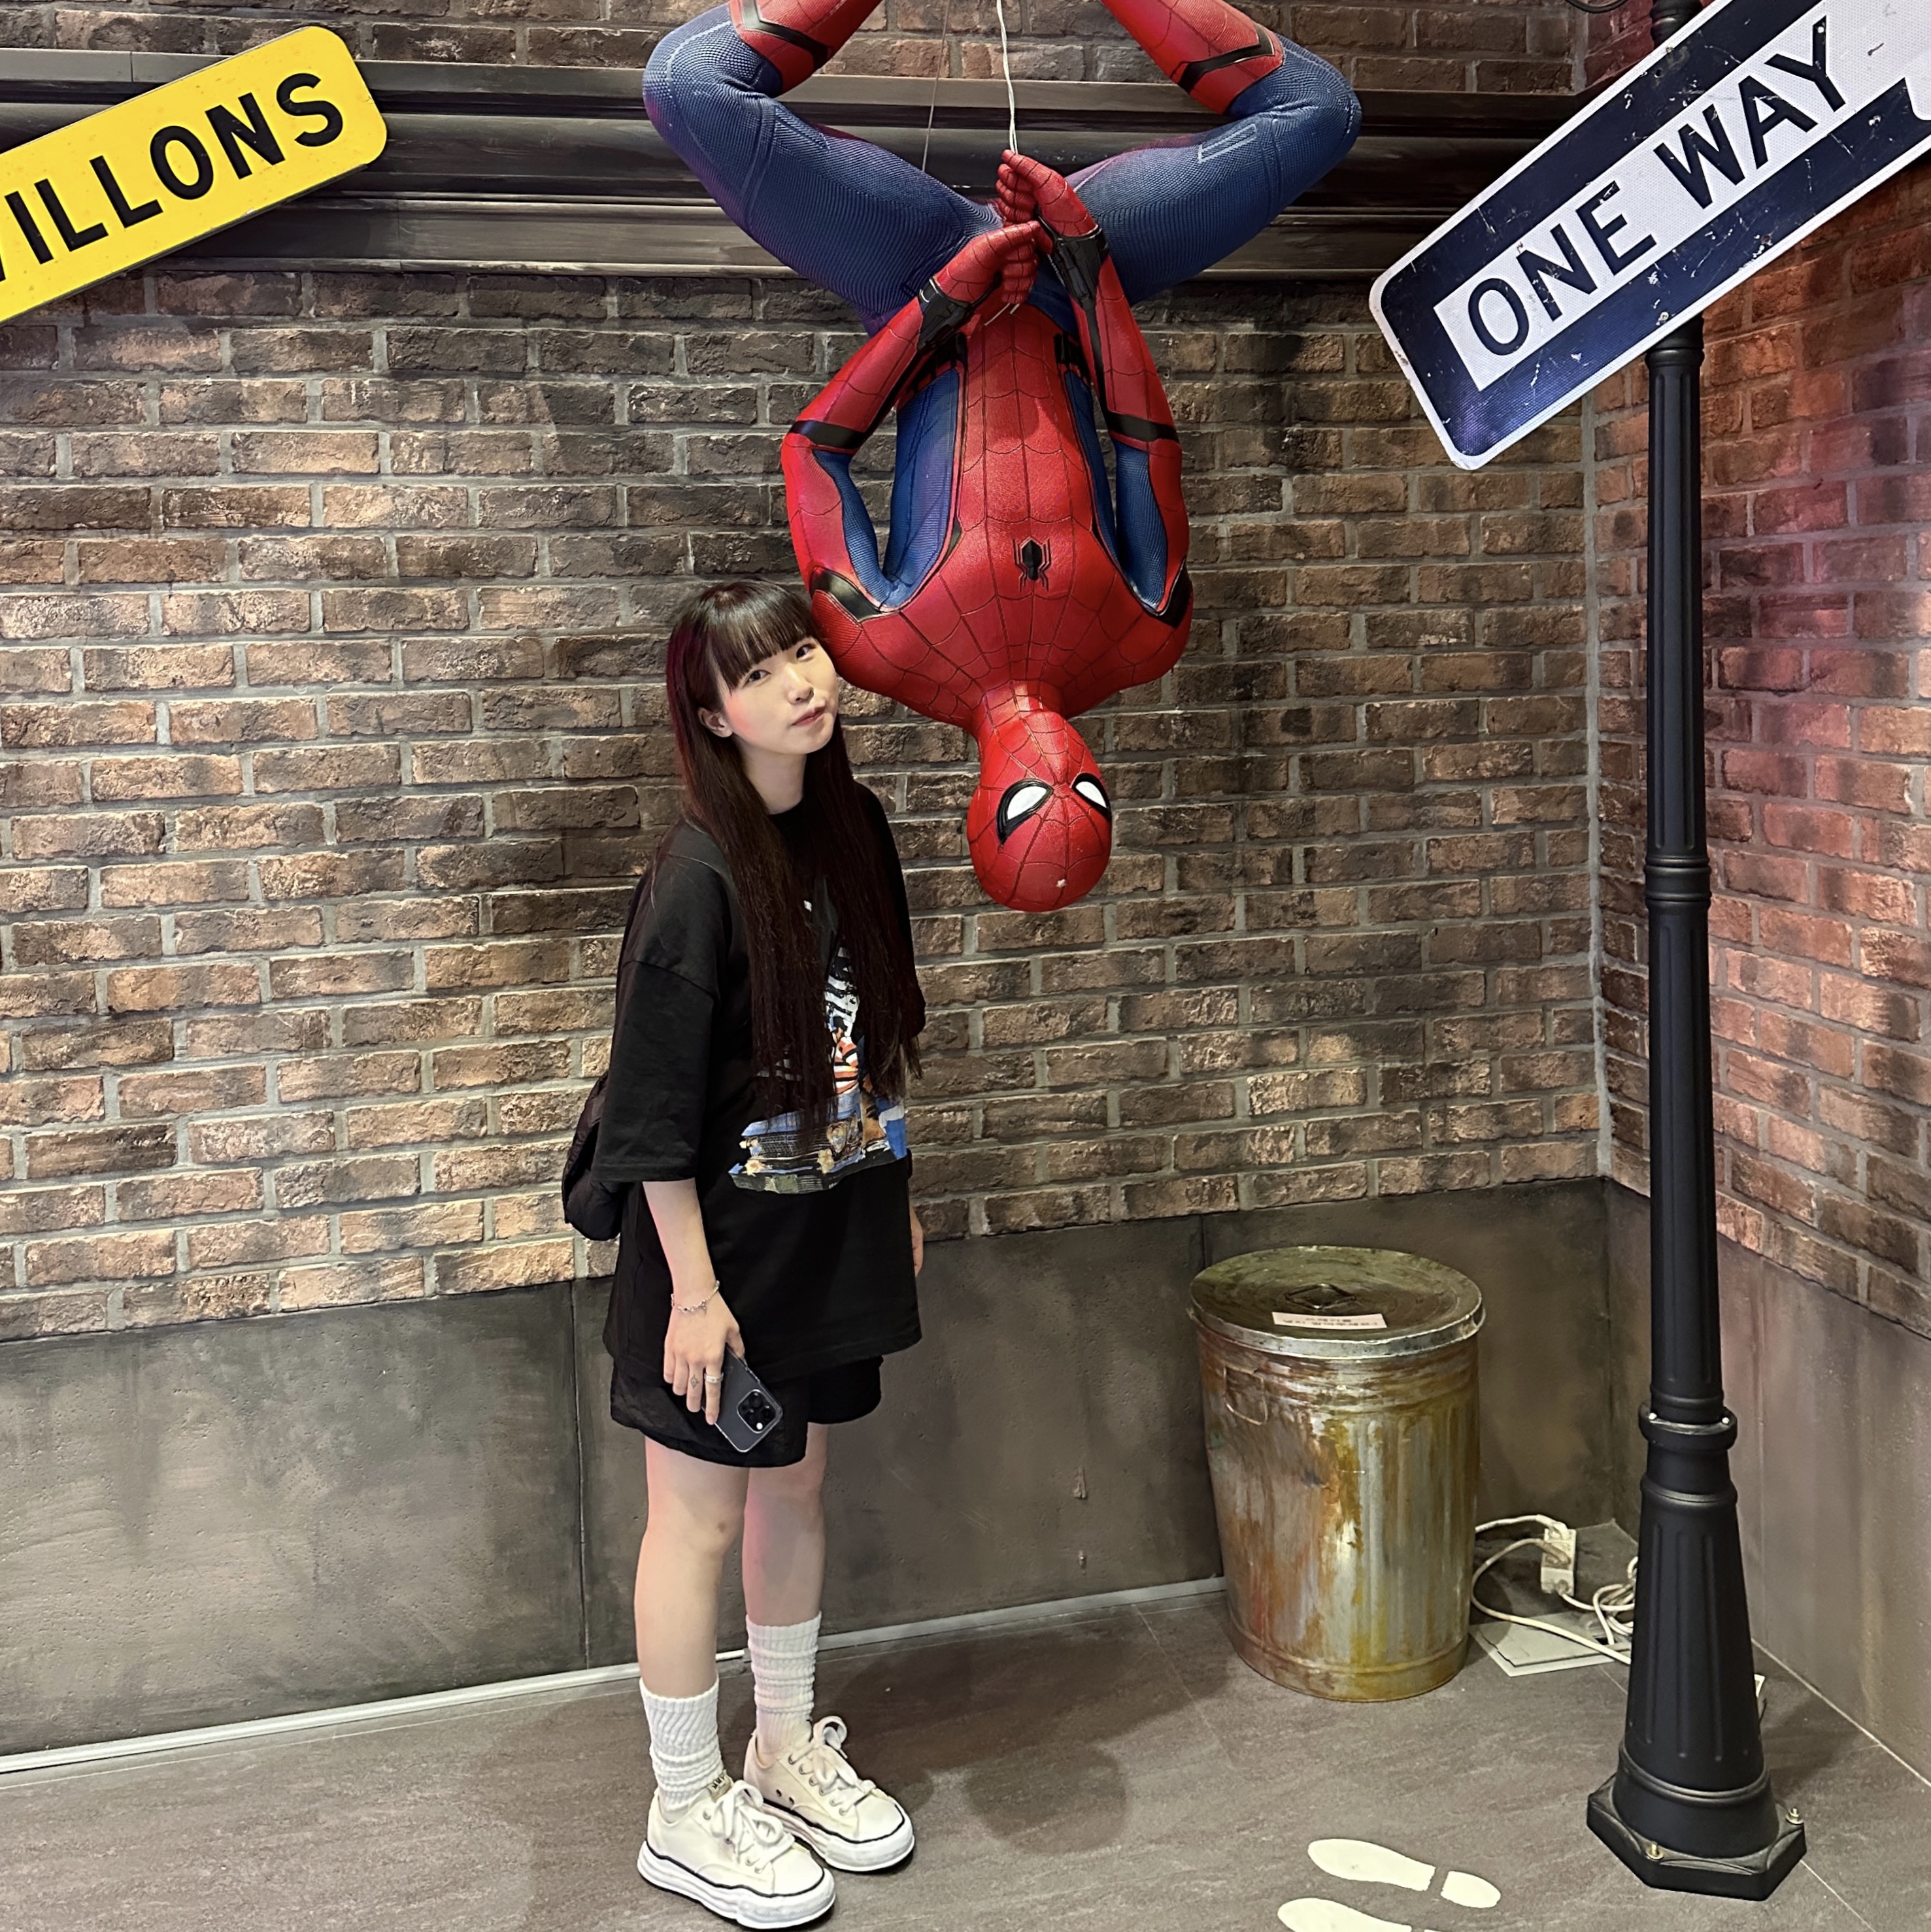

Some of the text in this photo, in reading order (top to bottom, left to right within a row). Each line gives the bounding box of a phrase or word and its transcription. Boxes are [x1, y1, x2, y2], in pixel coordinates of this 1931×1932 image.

[0, 73, 343, 282] ILLONS
[1468, 15, 1846, 356] ONE WAY
